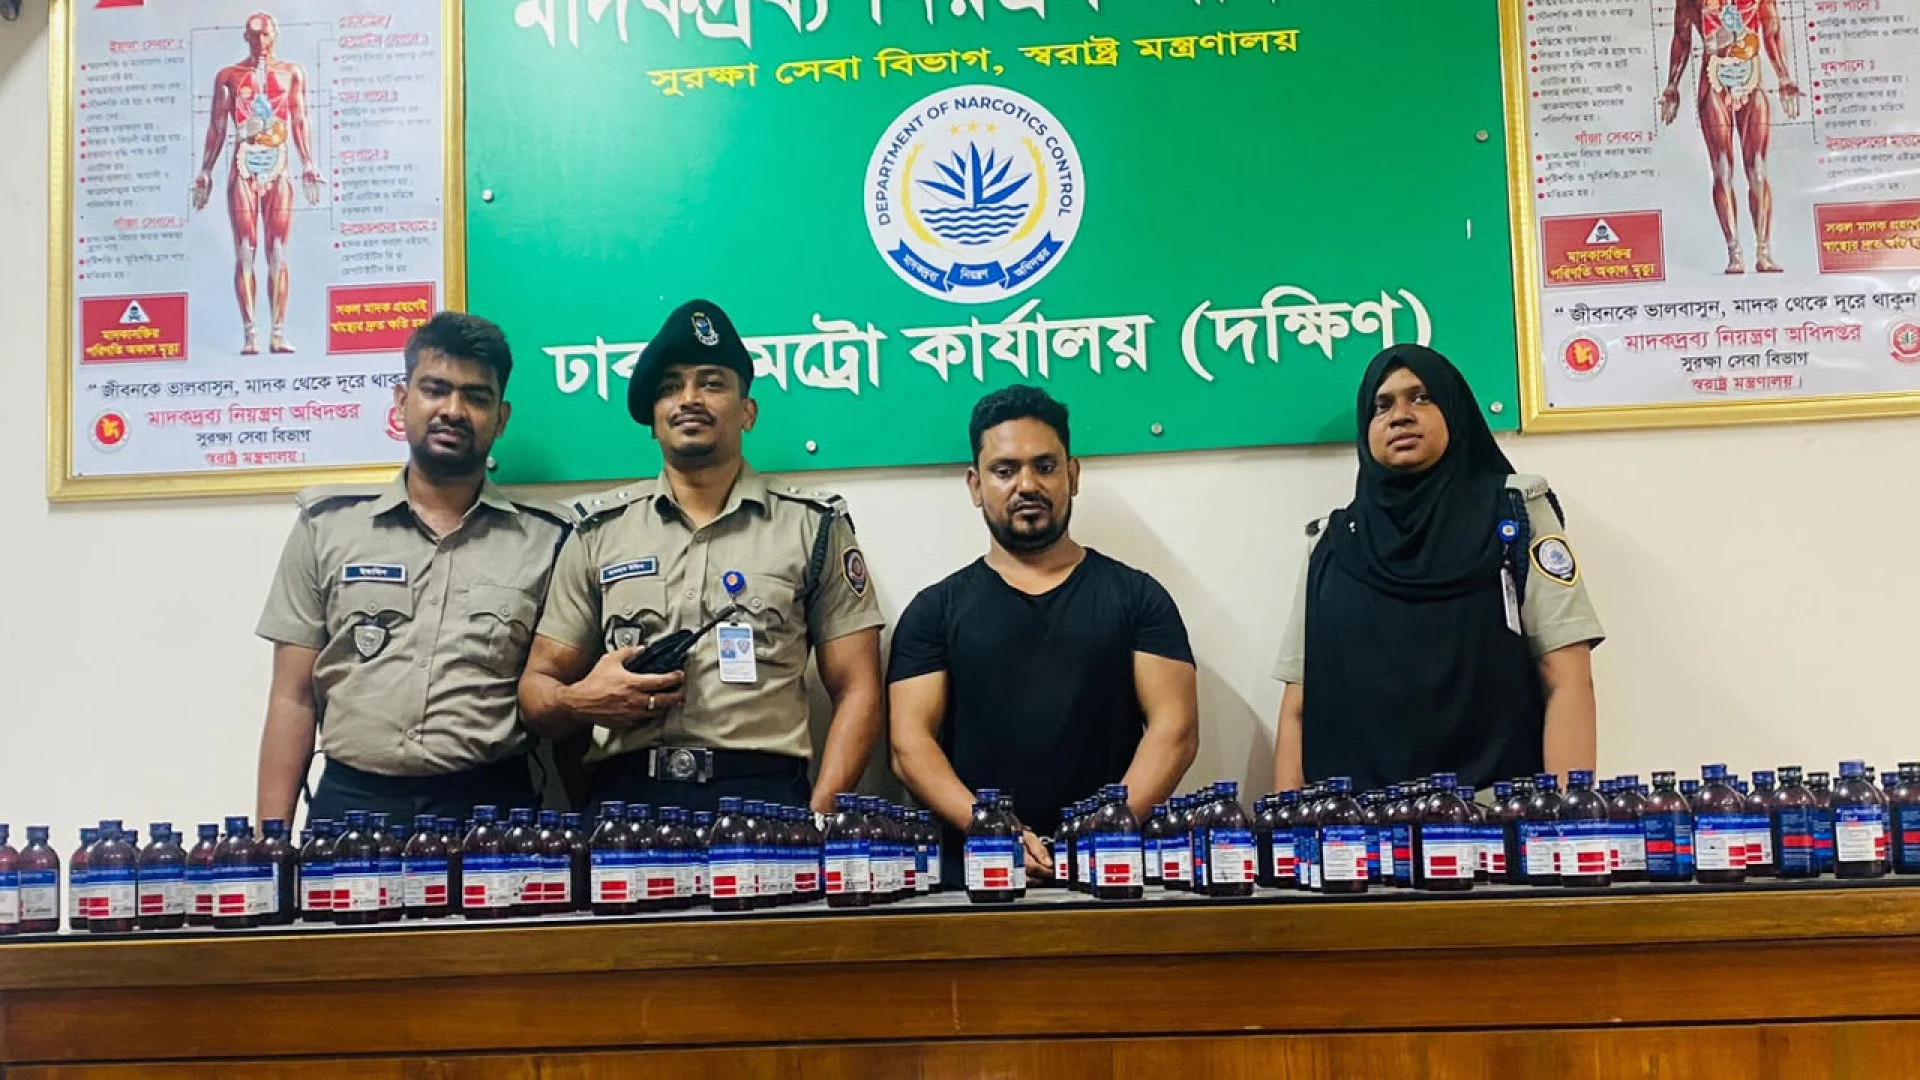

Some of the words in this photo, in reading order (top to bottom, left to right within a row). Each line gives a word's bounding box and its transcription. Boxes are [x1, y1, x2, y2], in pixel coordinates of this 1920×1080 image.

[647, 62, 759, 96] সুরক্ষা
[775, 56, 862, 84] সেবা
[873, 46, 1003, 78] বিভাগ,
[1018, 34, 1120, 66] স্বরাষ্ট্র
[1133, 28, 1300, 61] মন্ত্রণালয়
[876, 115, 924, 226] DEPARTMENT
[927, 102, 949, 119] OF
[954, 96, 1048, 136] NARCOTICS
[1045, 136, 1073, 217] CONTROL
[1569, 302, 1638, 324] জীবনকে
[1733, 299, 1778, 316] মাদক
[1785, 296, 1827, 312] থেকে
[1834, 294, 1866, 314] দূরে
[1872, 292, 1917, 312] থাকুন
[901, 299, 1155, 383] কার্যালয়
[1624, 331, 1709, 351] মাদকদ্রব্য
[1715, 326, 1777, 347] নিয়ন্ত্রণ
[1785, 322, 1862, 345] অধিদপ্তর
[1681, 354, 1721, 372] সুরক্ষা
[1727, 353, 1760, 368] সেবা
[1765, 349, 1809, 368] বিভাগ
[101, 380, 161, 399] জীবনকে
[246, 376, 286, 394] মাদক
[293, 374, 331, 390] থেকে
[335, 373, 366, 394] দূরে
[147, 409, 221, 427] মাদকদ্রব্য
[228, 404, 284, 425] নিয়ন্ত্রণ
[289, 400, 362, 424] অধিদপ্তর
[197, 430, 232, 448] সুরক্ষা
[238, 429, 268, 444] সেবা
[271, 426, 311, 443] বিভাগ
